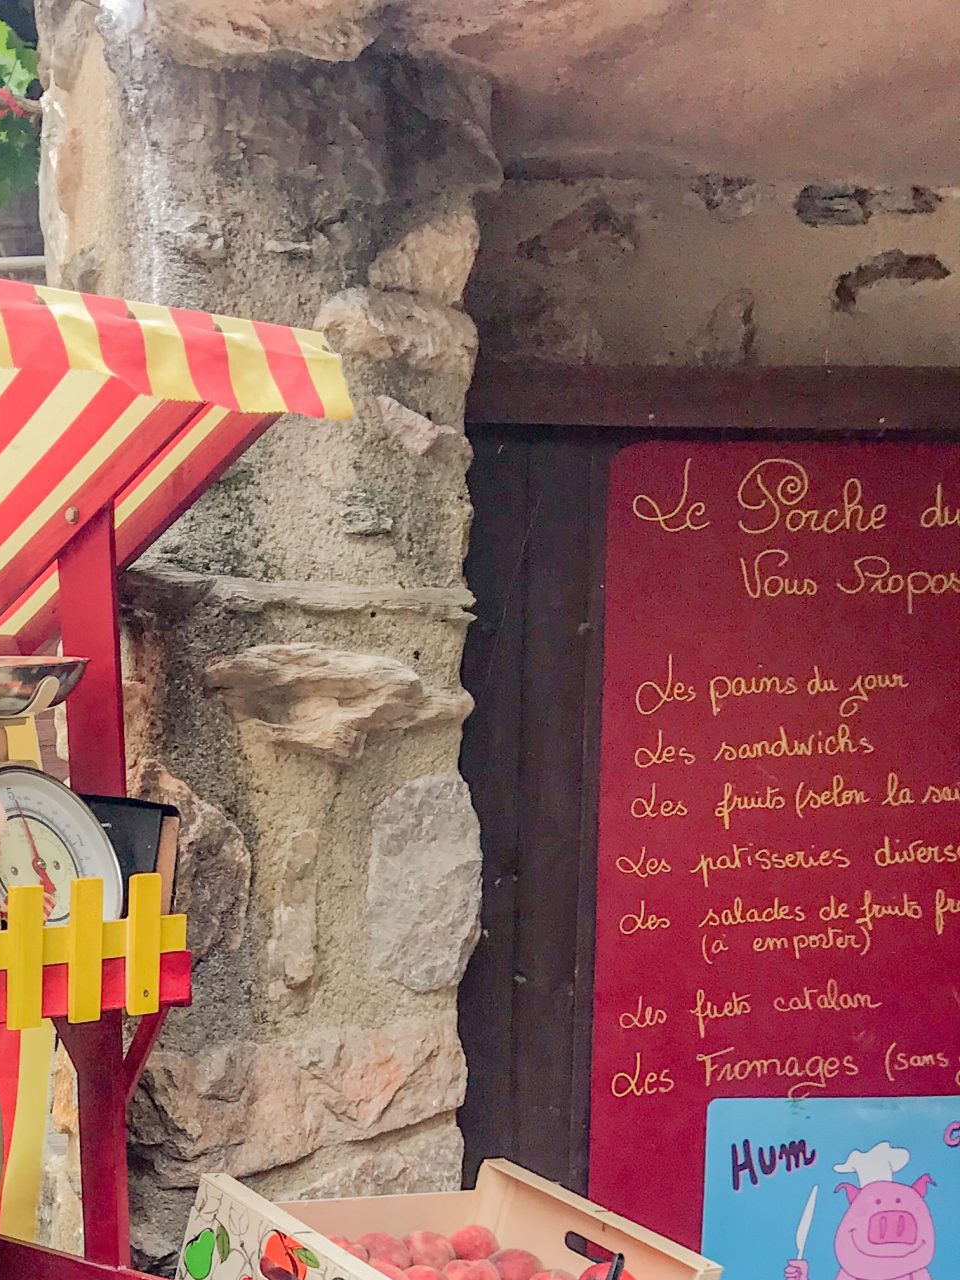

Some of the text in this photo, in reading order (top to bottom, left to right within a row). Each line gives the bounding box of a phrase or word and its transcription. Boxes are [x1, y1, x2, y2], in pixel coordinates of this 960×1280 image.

[633, 458, 709, 532] Le
[738, 458, 886, 533] Porche
[741, 550, 817, 598] Vous
[636, 654, 908, 716] Les pains du jour
[635, 725, 874, 767] Les sandwichs
[631, 783, 687, 818] Les
[715, 783, 785, 829] fruits
[796, 775, 870, 818] (selon
[882, 772, 915, 806] la
[616, 846, 671, 877] Les
[690, 844, 850, 887] patisseries
[619, 900, 670, 934] Les
[699, 897, 805, 928] salades
[819, 896, 849, 921] de
[856, 890, 921, 930] fruits
[619, 978, 881, 1038] Les fuets catalan
[611, 1053, 674, 1097] Les
[697, 1047, 858, 1100] Fromages
[885, 1043, 949, 1081] (sans
[731, 1139, 817, 1191] Hum
